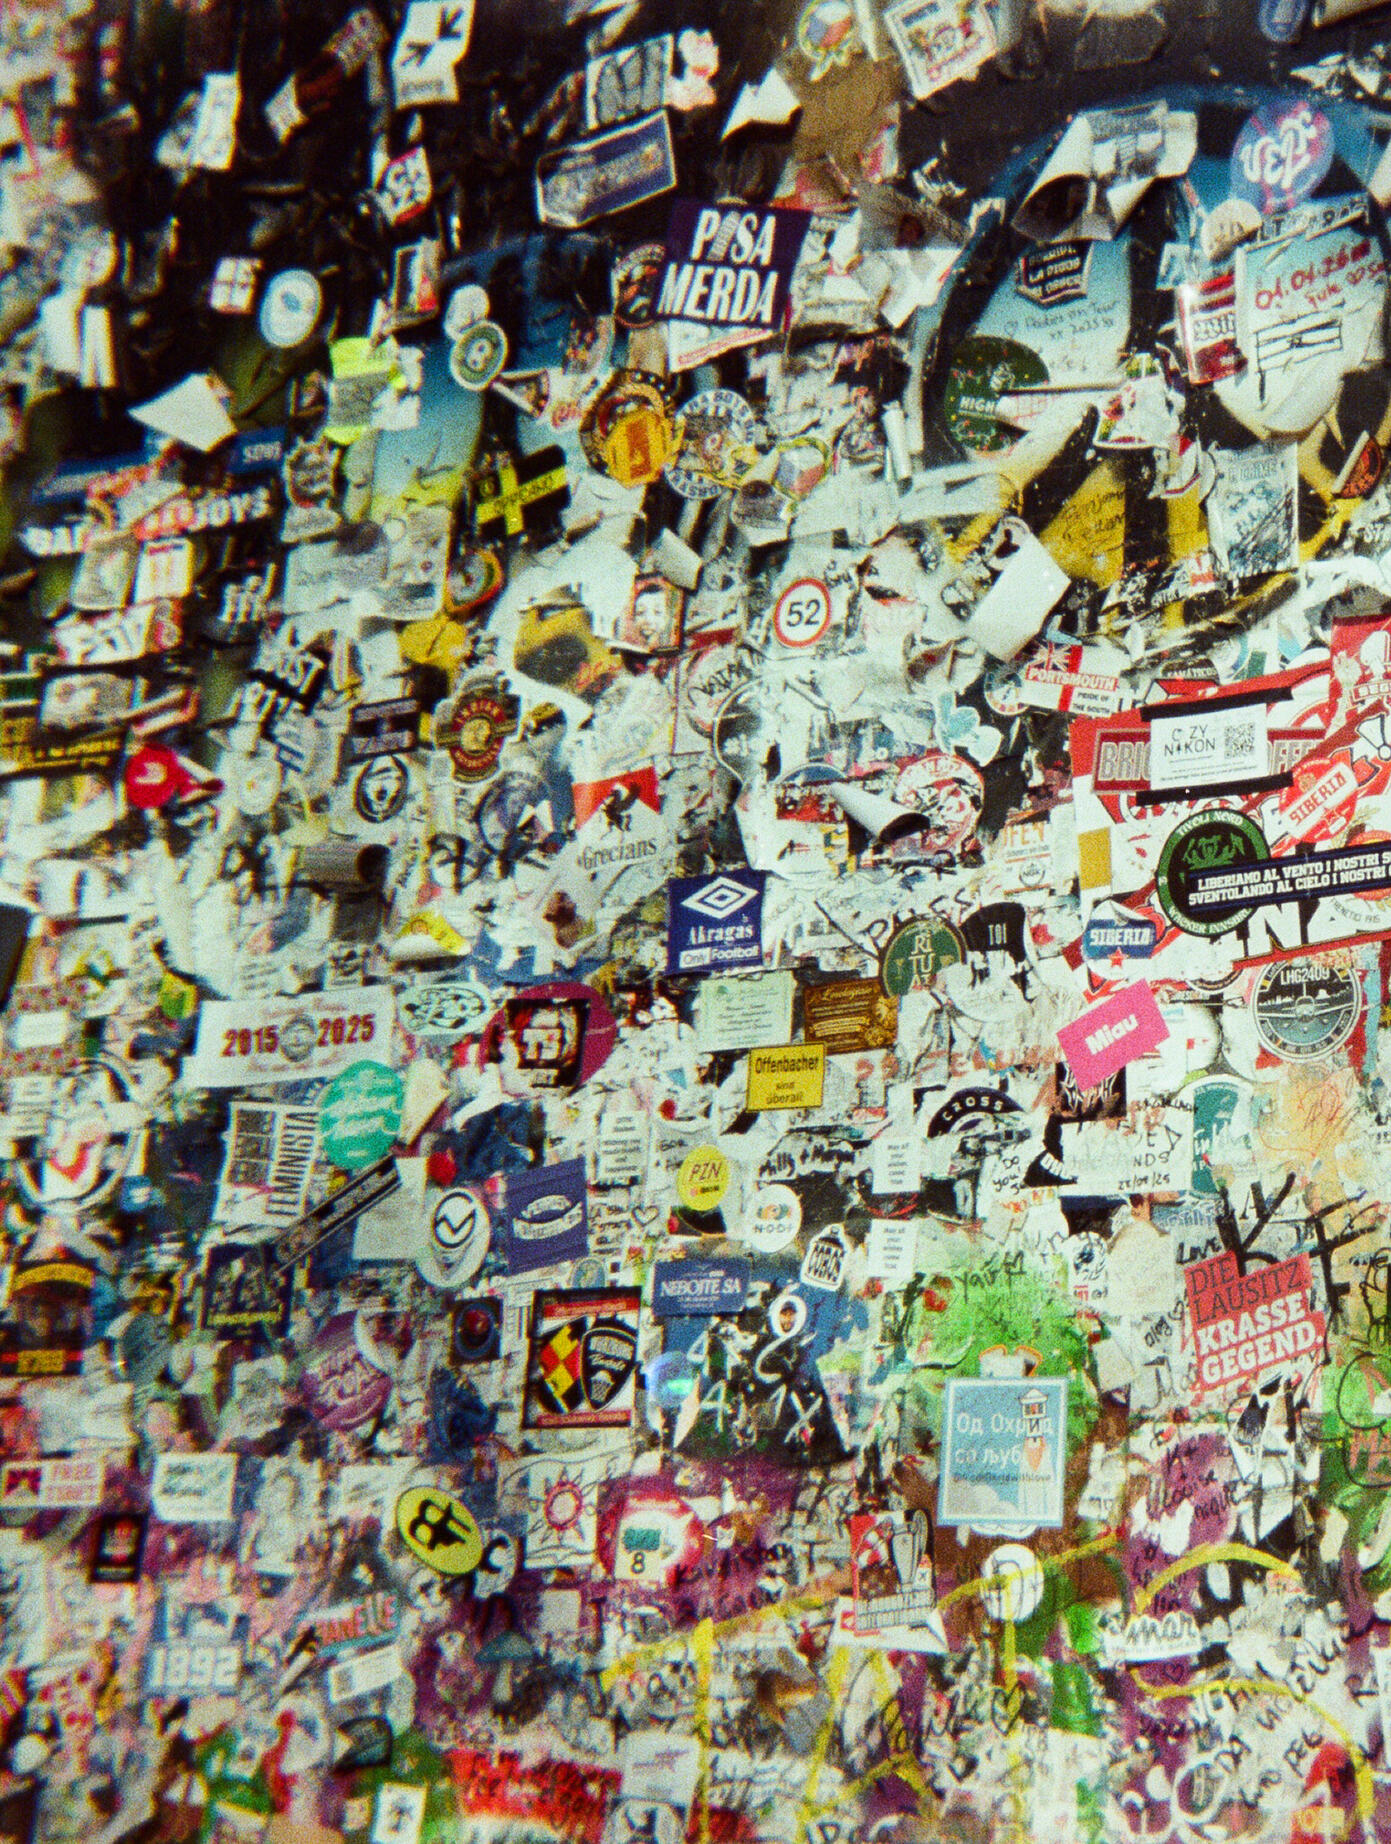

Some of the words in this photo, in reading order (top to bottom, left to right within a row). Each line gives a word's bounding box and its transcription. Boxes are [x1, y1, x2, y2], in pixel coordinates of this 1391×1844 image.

[656, 262, 779, 323] MERDA
[785, 598, 821, 628] 52
[1029, 668, 1117, 692] PORTSMOUTH
[1164, 738, 1216, 757] NIKON
[1289, 771, 1347, 825] SIBERIA
[1175, 814, 1212, 837] TIVOLI
[1213, 812, 1244, 827] NORD
[1188, 882, 1274, 906] SVENTOLANDO
[1275, 878, 1293, 893] AL
[1294, 875, 1331, 892] CIELO
[1339, 867, 1386, 884] NOSTRI
[1197, 869, 1261, 891] LIBERIAMO
[1262, 866, 1280, 880] AL
[1281, 861, 1324, 878] VENTO
[1333, 851, 1379, 871] NOSTRI
[1089, 927, 1152, 947] SIBERIA
[222, 1025, 280, 1057] 2015
[316, 1012, 376, 1047] 2025
[1085, 1013, 1139, 1056] Miau
[754, 1054, 820, 1075] Offenbacher
[721, 1277, 742, 1294] SA
[1190, 1259, 1235, 1296] DIE
[1195, 1293, 1306, 1356] KRASSE
[1200, 1321, 1323, 1385] GEGEND.
[632, 1551, 646, 1575] 8
